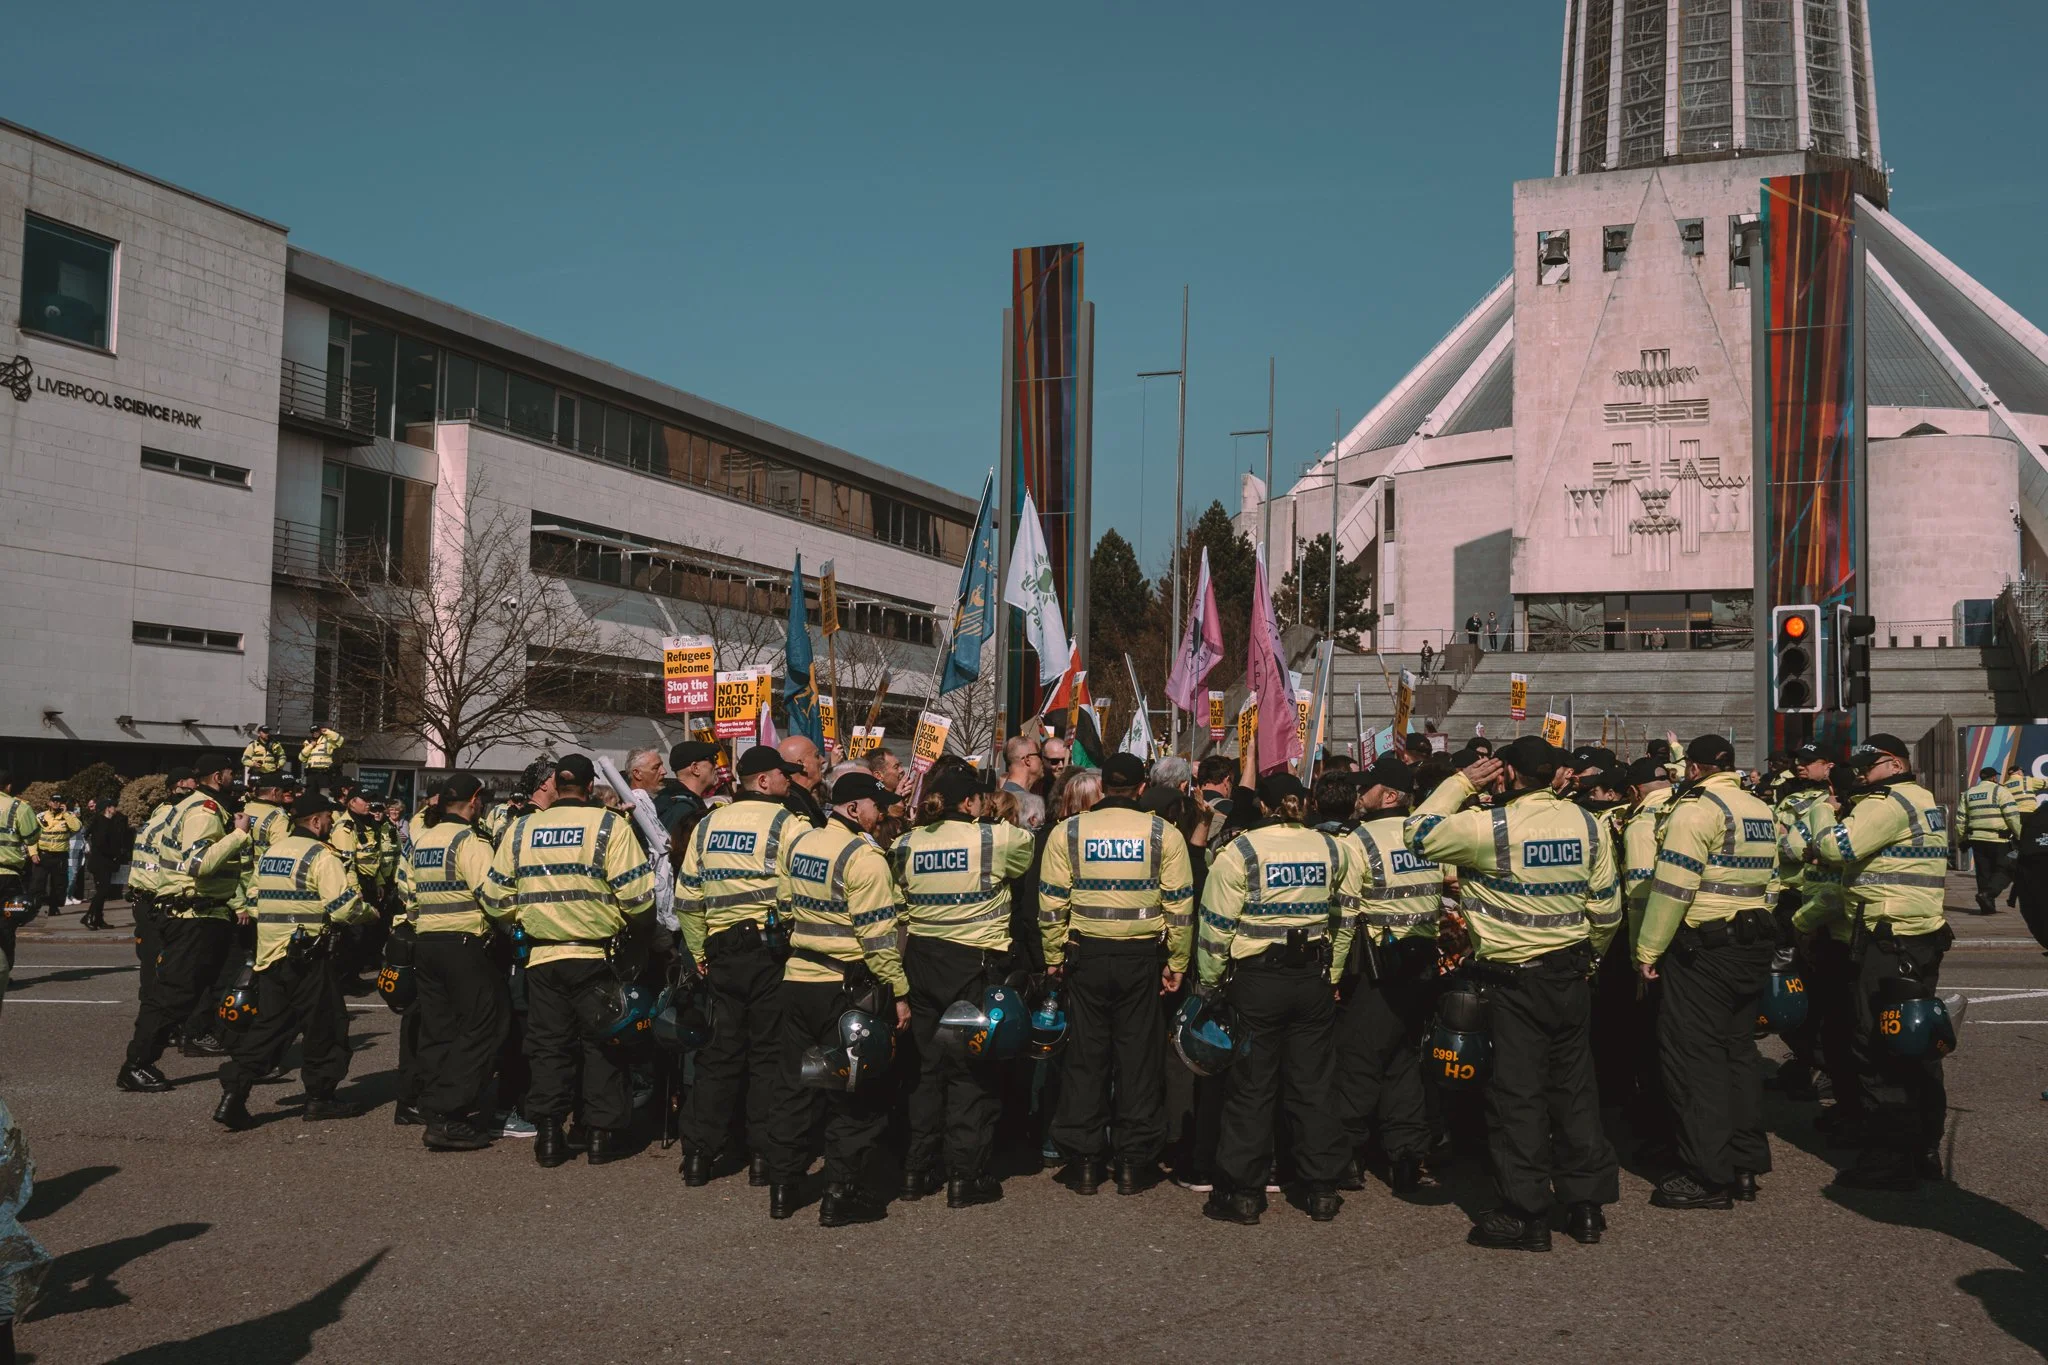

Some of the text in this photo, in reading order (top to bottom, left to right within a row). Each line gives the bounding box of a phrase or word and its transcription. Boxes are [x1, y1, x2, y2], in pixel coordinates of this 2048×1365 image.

[37, 376, 202, 429] LIVERPOOL SCIENCE PARK
[667, 651, 711, 663] Refugees
[667, 664, 709, 674] welcome
[667, 679, 708, 692] Stop the
[718, 683, 748, 695] NO TO
[1512, 682, 1519, 690] NO
[667, 692, 708, 705] far right
[718, 694, 754, 707] RACIST
[717, 707, 741, 718] UKIP
[820, 706, 831, 716] TO
[1241, 704, 1258, 723] STOP
[927, 725, 936, 734] TO
[1241, 719, 1253, 734] THE
[865, 738, 876, 748] TO
[920, 732, 939, 744] ACISM.
[923, 740, 931, 749] TO
[915, 746, 938, 759] ASCISM.
[1969, 792, 1987, 800] POLICE
[533, 830, 582, 846] POLICE
[1744, 821, 1775, 841] POLICE
[709, 833, 754, 851] POLICE
[1087, 840, 1143, 859] POLICE
[1526, 843, 1580, 864] POLICE
[415, 850, 443, 866] POLICE
[915, 851, 967, 871] POLICE
[260, 860, 292, 873] POLICE
[792, 856, 827, 881] POLICE
[1268, 865, 1324, 884] POLICE
[378, 976, 395, 992] CH
[1786, 977, 1804, 993] CH
[219, 1006, 239, 1021] CH
[1880, 1020, 1901, 1034] CH
[1433, 1047, 1459, 1062] 1663
[1444, 1062, 1475, 1080] CH
